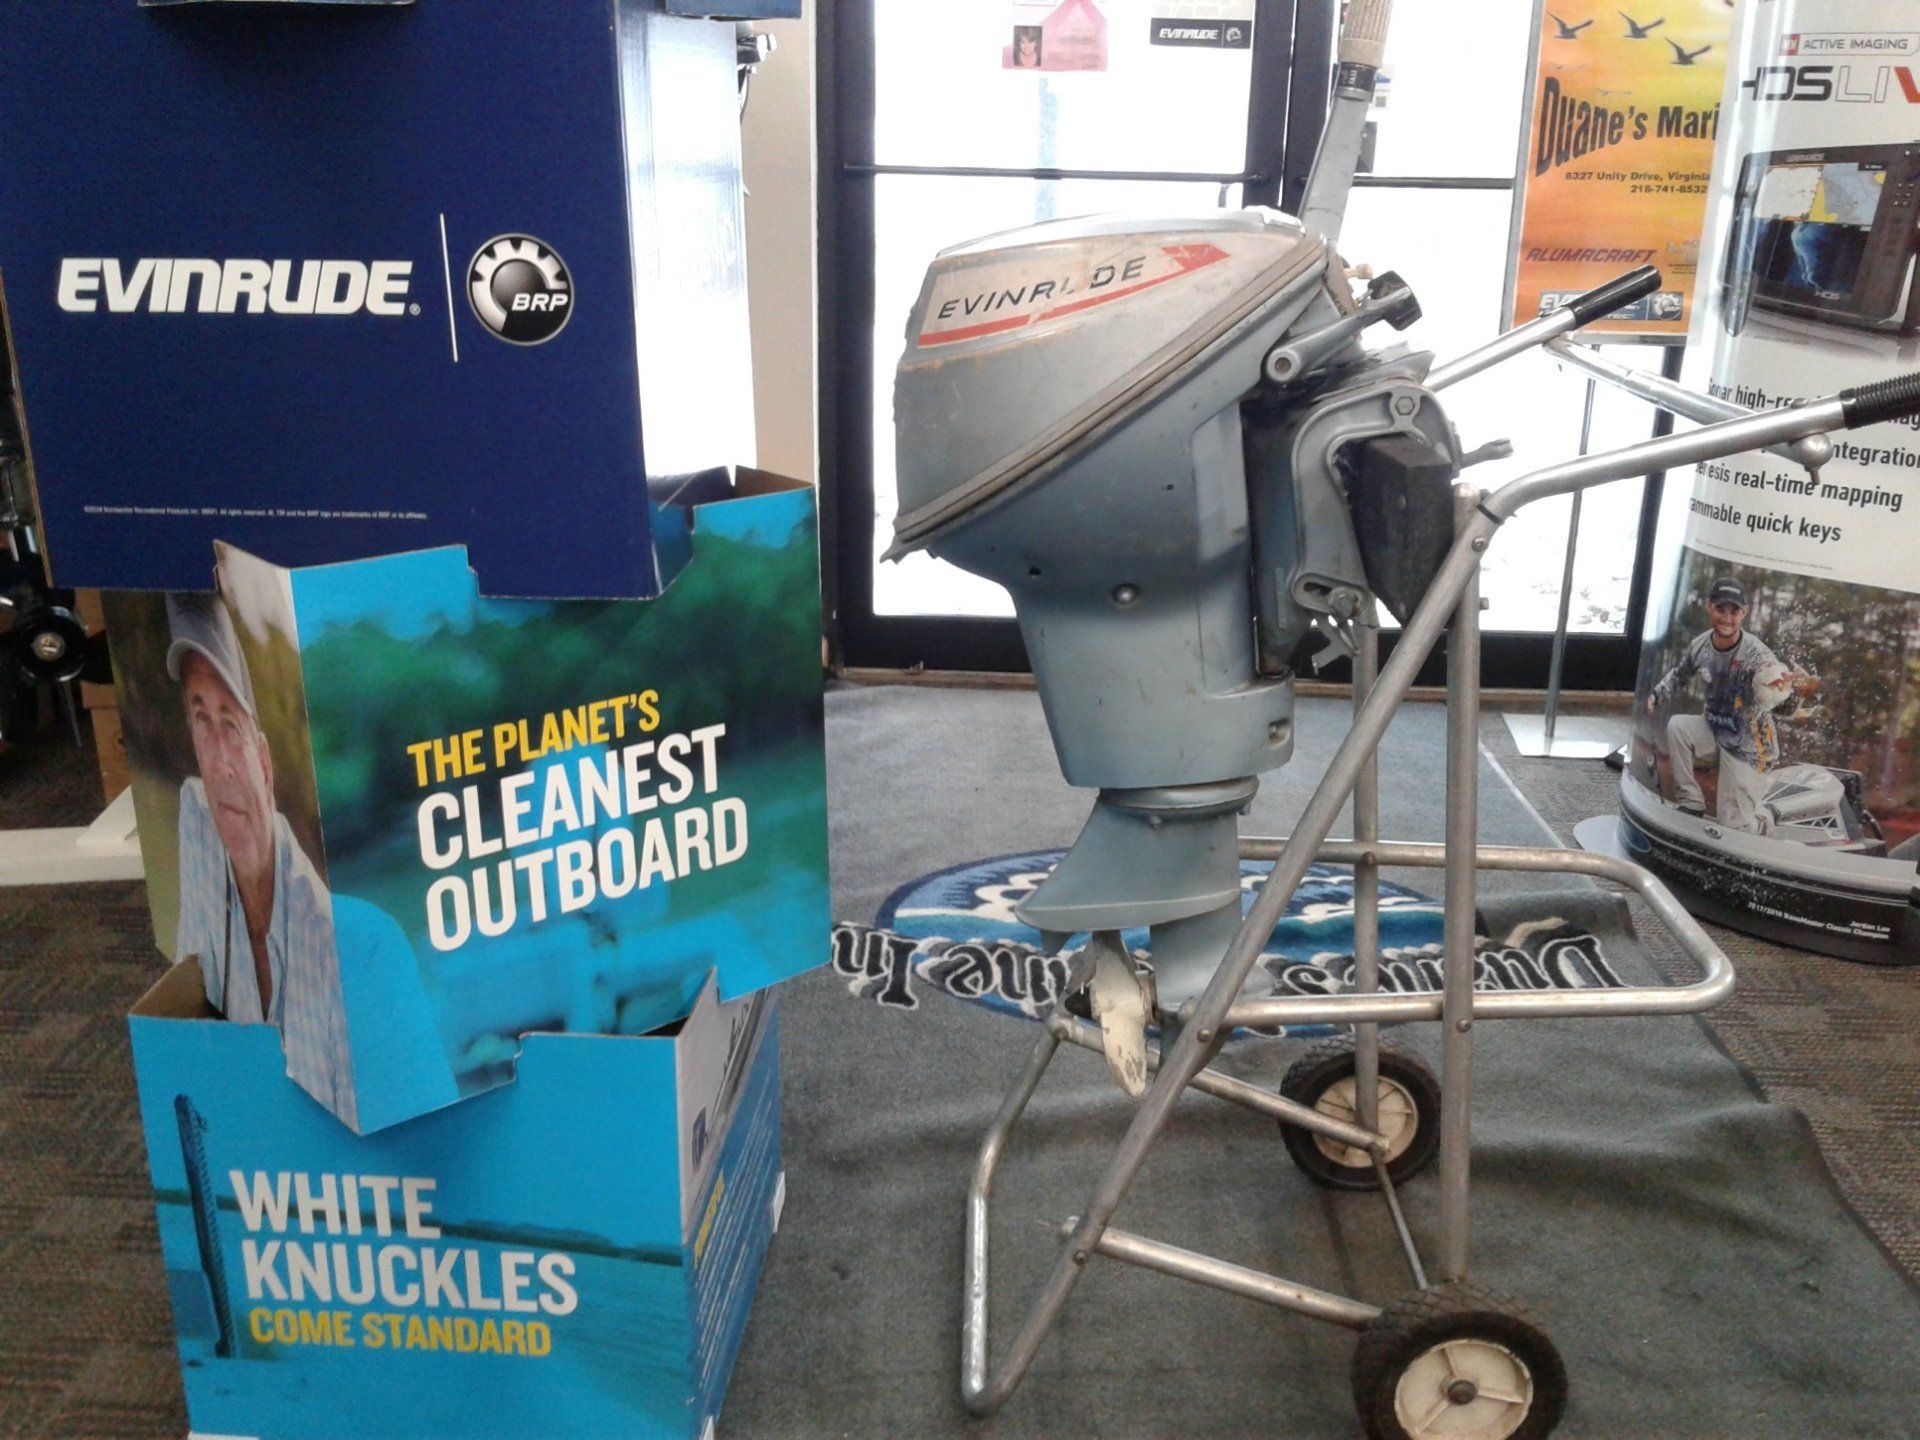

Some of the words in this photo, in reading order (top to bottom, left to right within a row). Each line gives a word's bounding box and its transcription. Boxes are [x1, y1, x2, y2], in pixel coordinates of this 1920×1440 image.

[1159, 28, 1218, 40] EVINRUDE
[1804, 39, 1845, 49] ACTIVE
[1850, 38, 1908, 50] IMAGING
[1535, 76, 1648, 177] Duane's
[1565, 172, 1593, 181] 8327
[1597, 172, 1626, 183] Unity
[1525, 248, 1657, 262] ALUMACRAFT
[511, 292, 568, 312] BRP
[1734, 470, 1816, 497] real-time
[1821, 483, 1904, 512] mapping
[1746, 512, 1794, 534] quick
[1799, 517, 1842, 544] keys
[407, 729, 486, 787] THE
[493, 689, 660, 767] PLANET'S
[417, 723, 725, 870] CLEANEST
[426, 797, 748, 951] OUTBOARD
[229, 1169, 441, 1240] WHITE
[241, 1239, 578, 1316] KNUCKLES
[250, 1308, 355, 1347] COME
[362, 1313, 552, 1357] STANDARD
